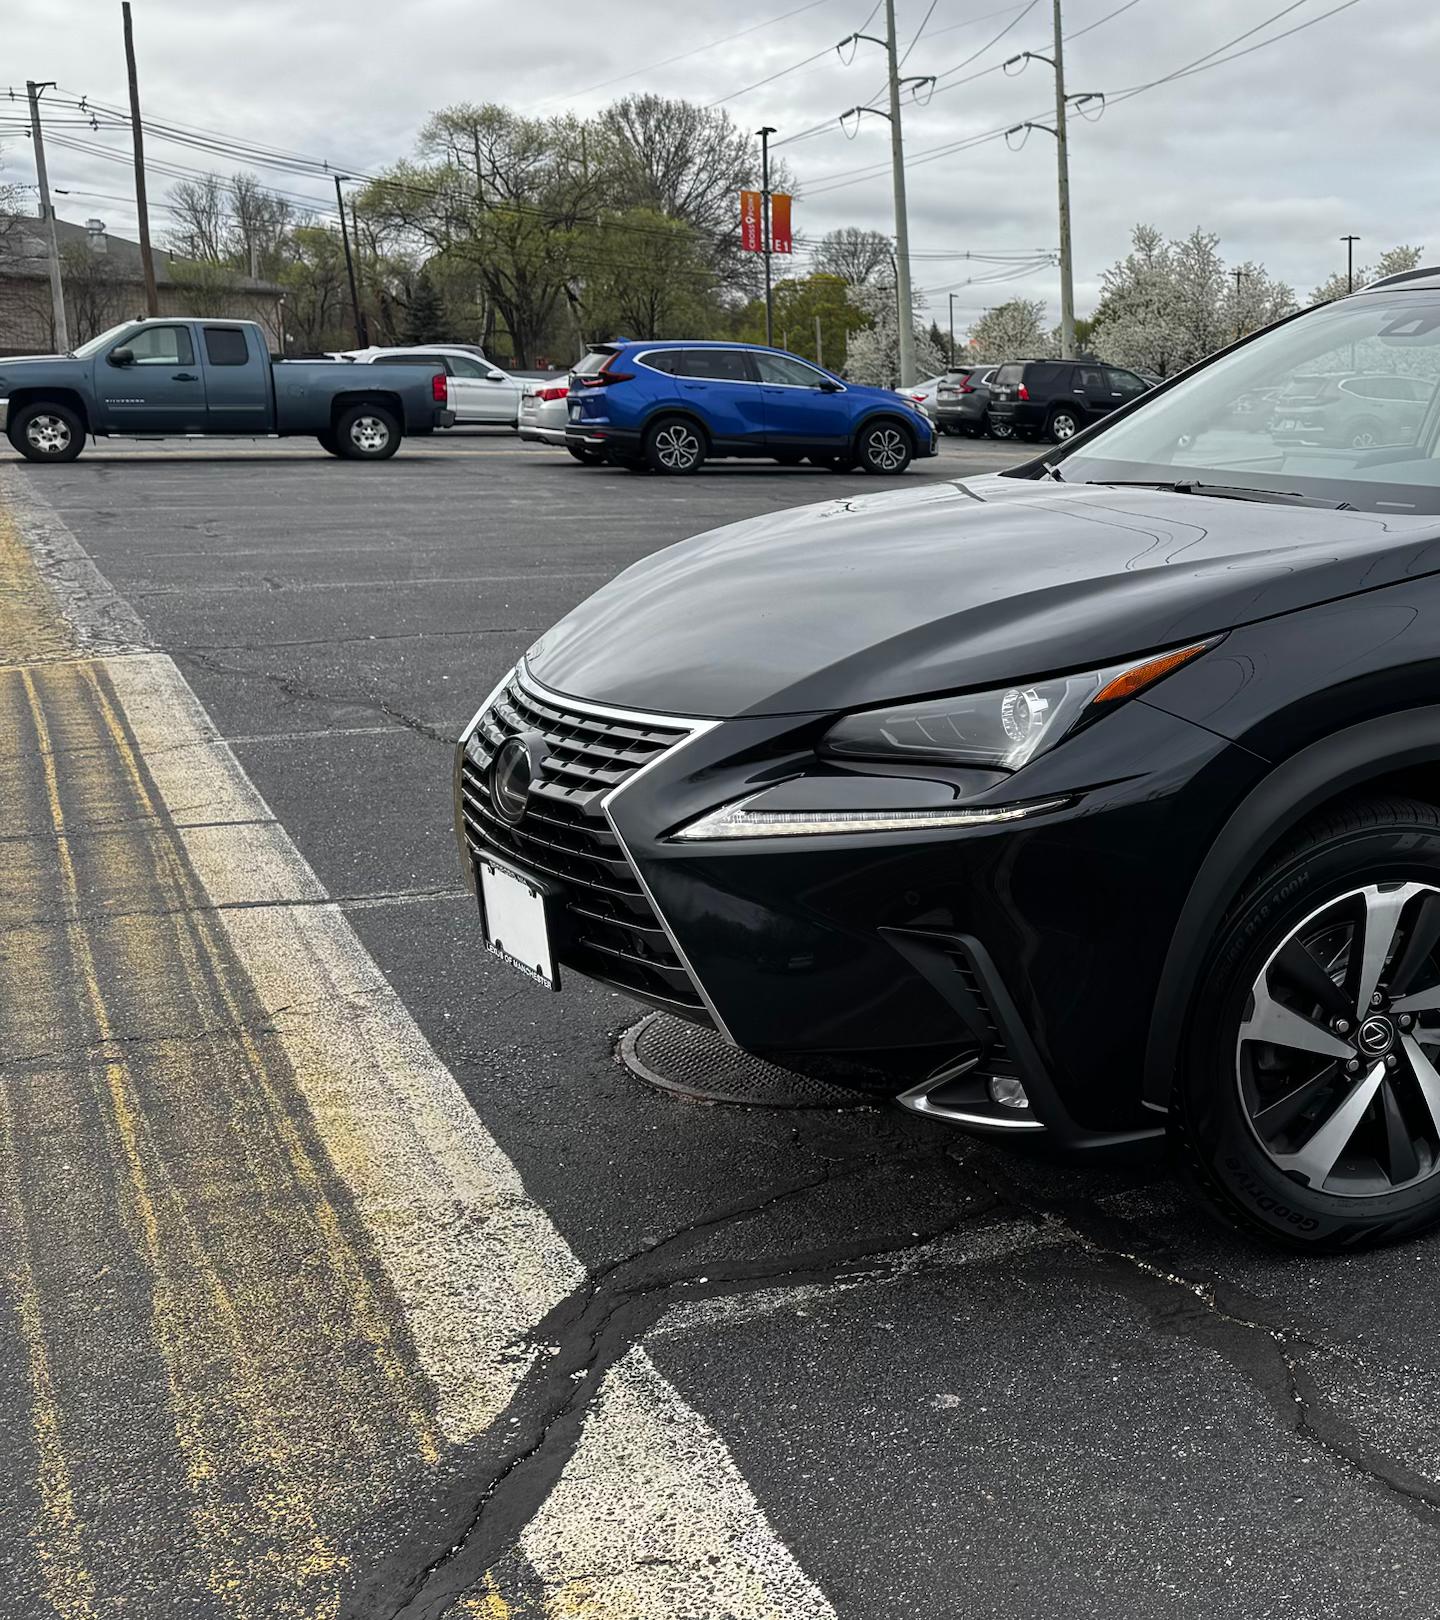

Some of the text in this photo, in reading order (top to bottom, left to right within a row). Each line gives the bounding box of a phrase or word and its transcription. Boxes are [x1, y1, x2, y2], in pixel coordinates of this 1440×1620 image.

[748, 224, 756, 249] CROSS
[775, 239, 789, 252] E1
[504, 953, 513, 965] OF
[1224, 1157, 1320, 1232] GeoDrive
